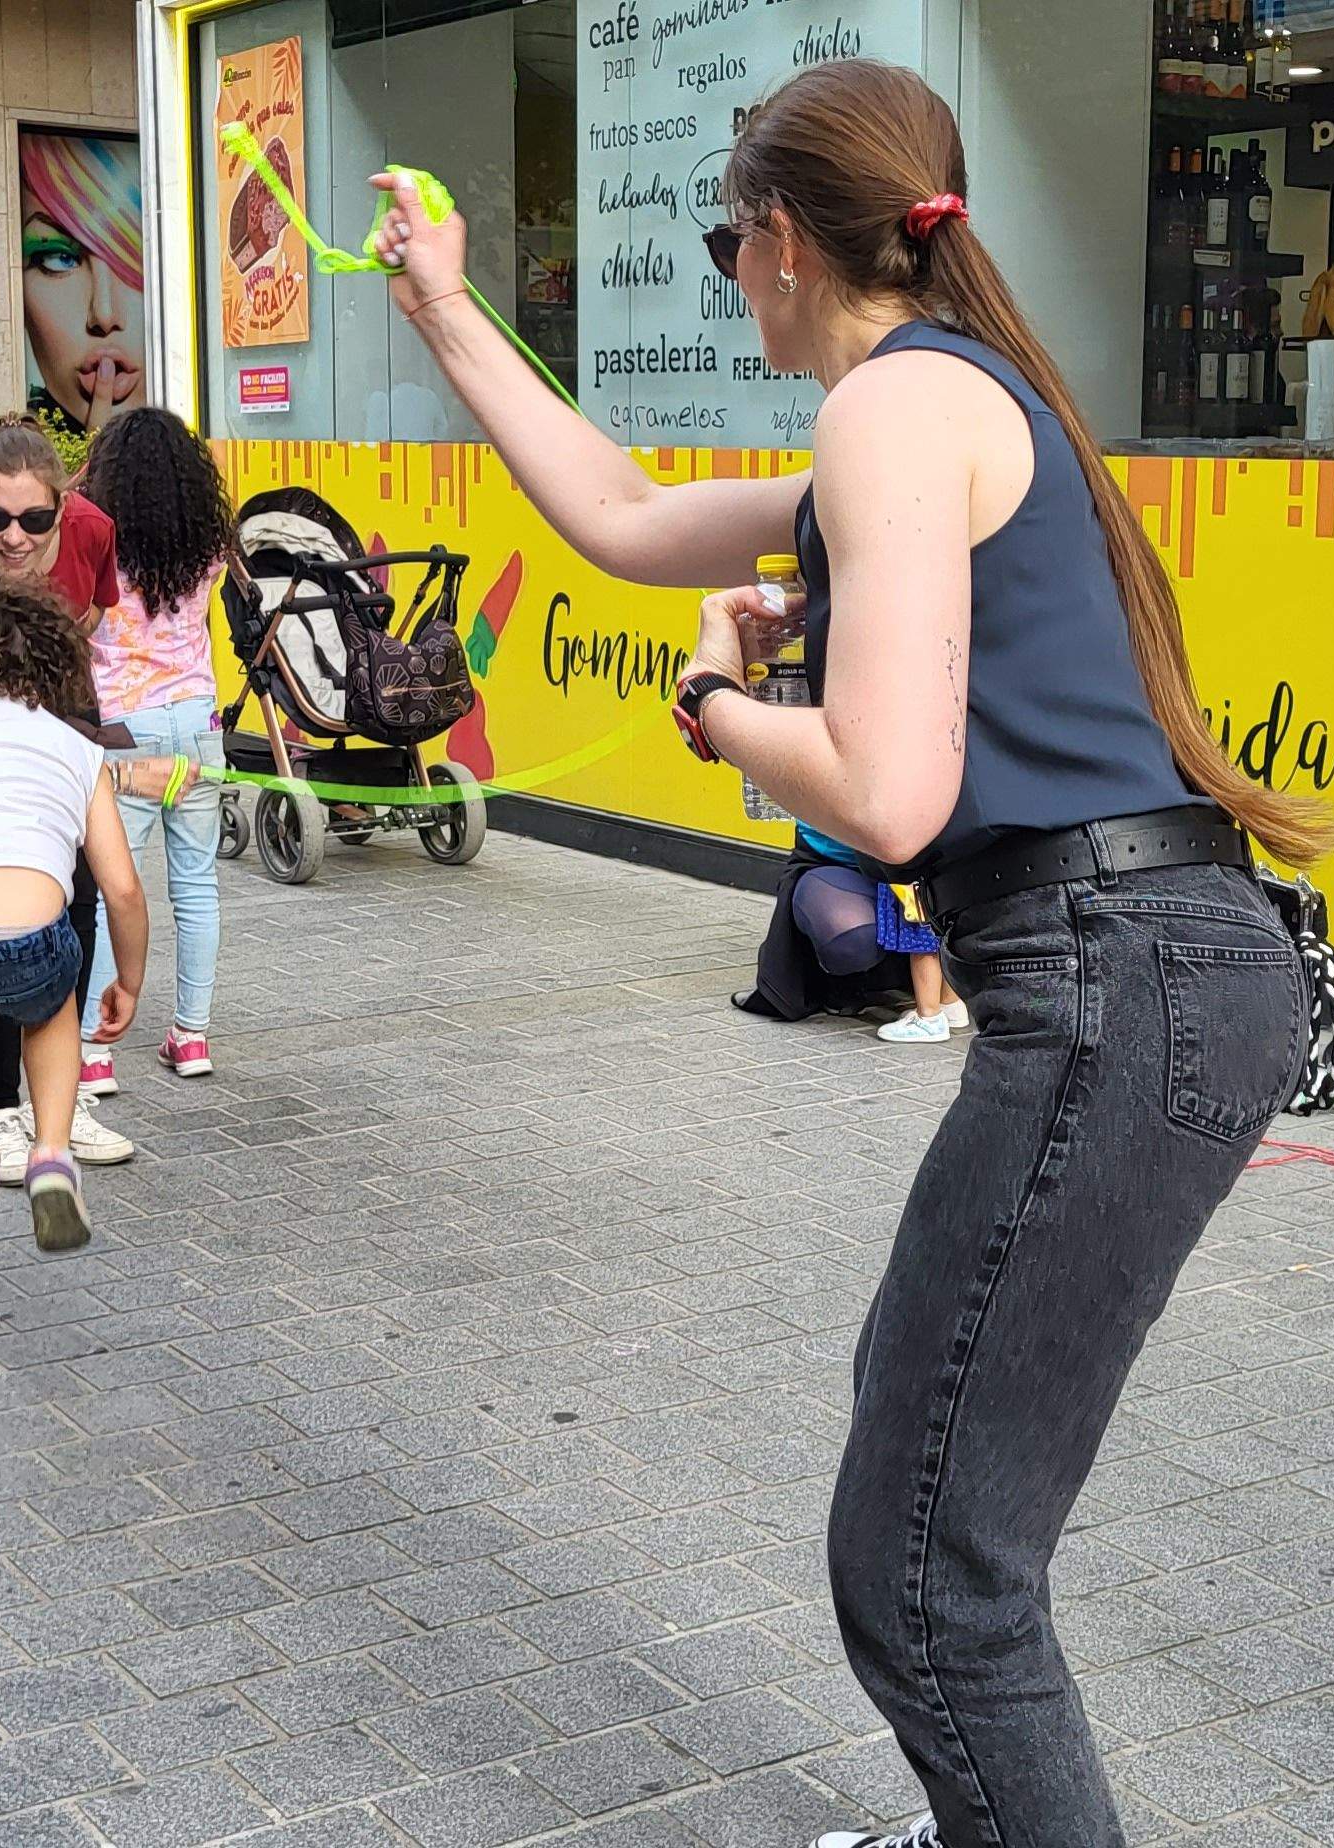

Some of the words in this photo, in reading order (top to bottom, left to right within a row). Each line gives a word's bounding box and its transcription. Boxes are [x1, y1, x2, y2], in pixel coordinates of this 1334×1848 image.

[589, 0, 640, 48] café
[792, 17, 861, 67] chicles
[603, 56, 636, 92] pan
[677, 53, 747, 93] regalos
[589, 123, 639, 151] frutos
[644, 115, 697, 141] secos
[599, 172, 680, 219] helados
[602, 238, 674, 289] chicles
[253, 265, 294, 316] GRATIS
[594, 333, 718, 388] pastelería
[610, 401, 729, 428] caramelos
